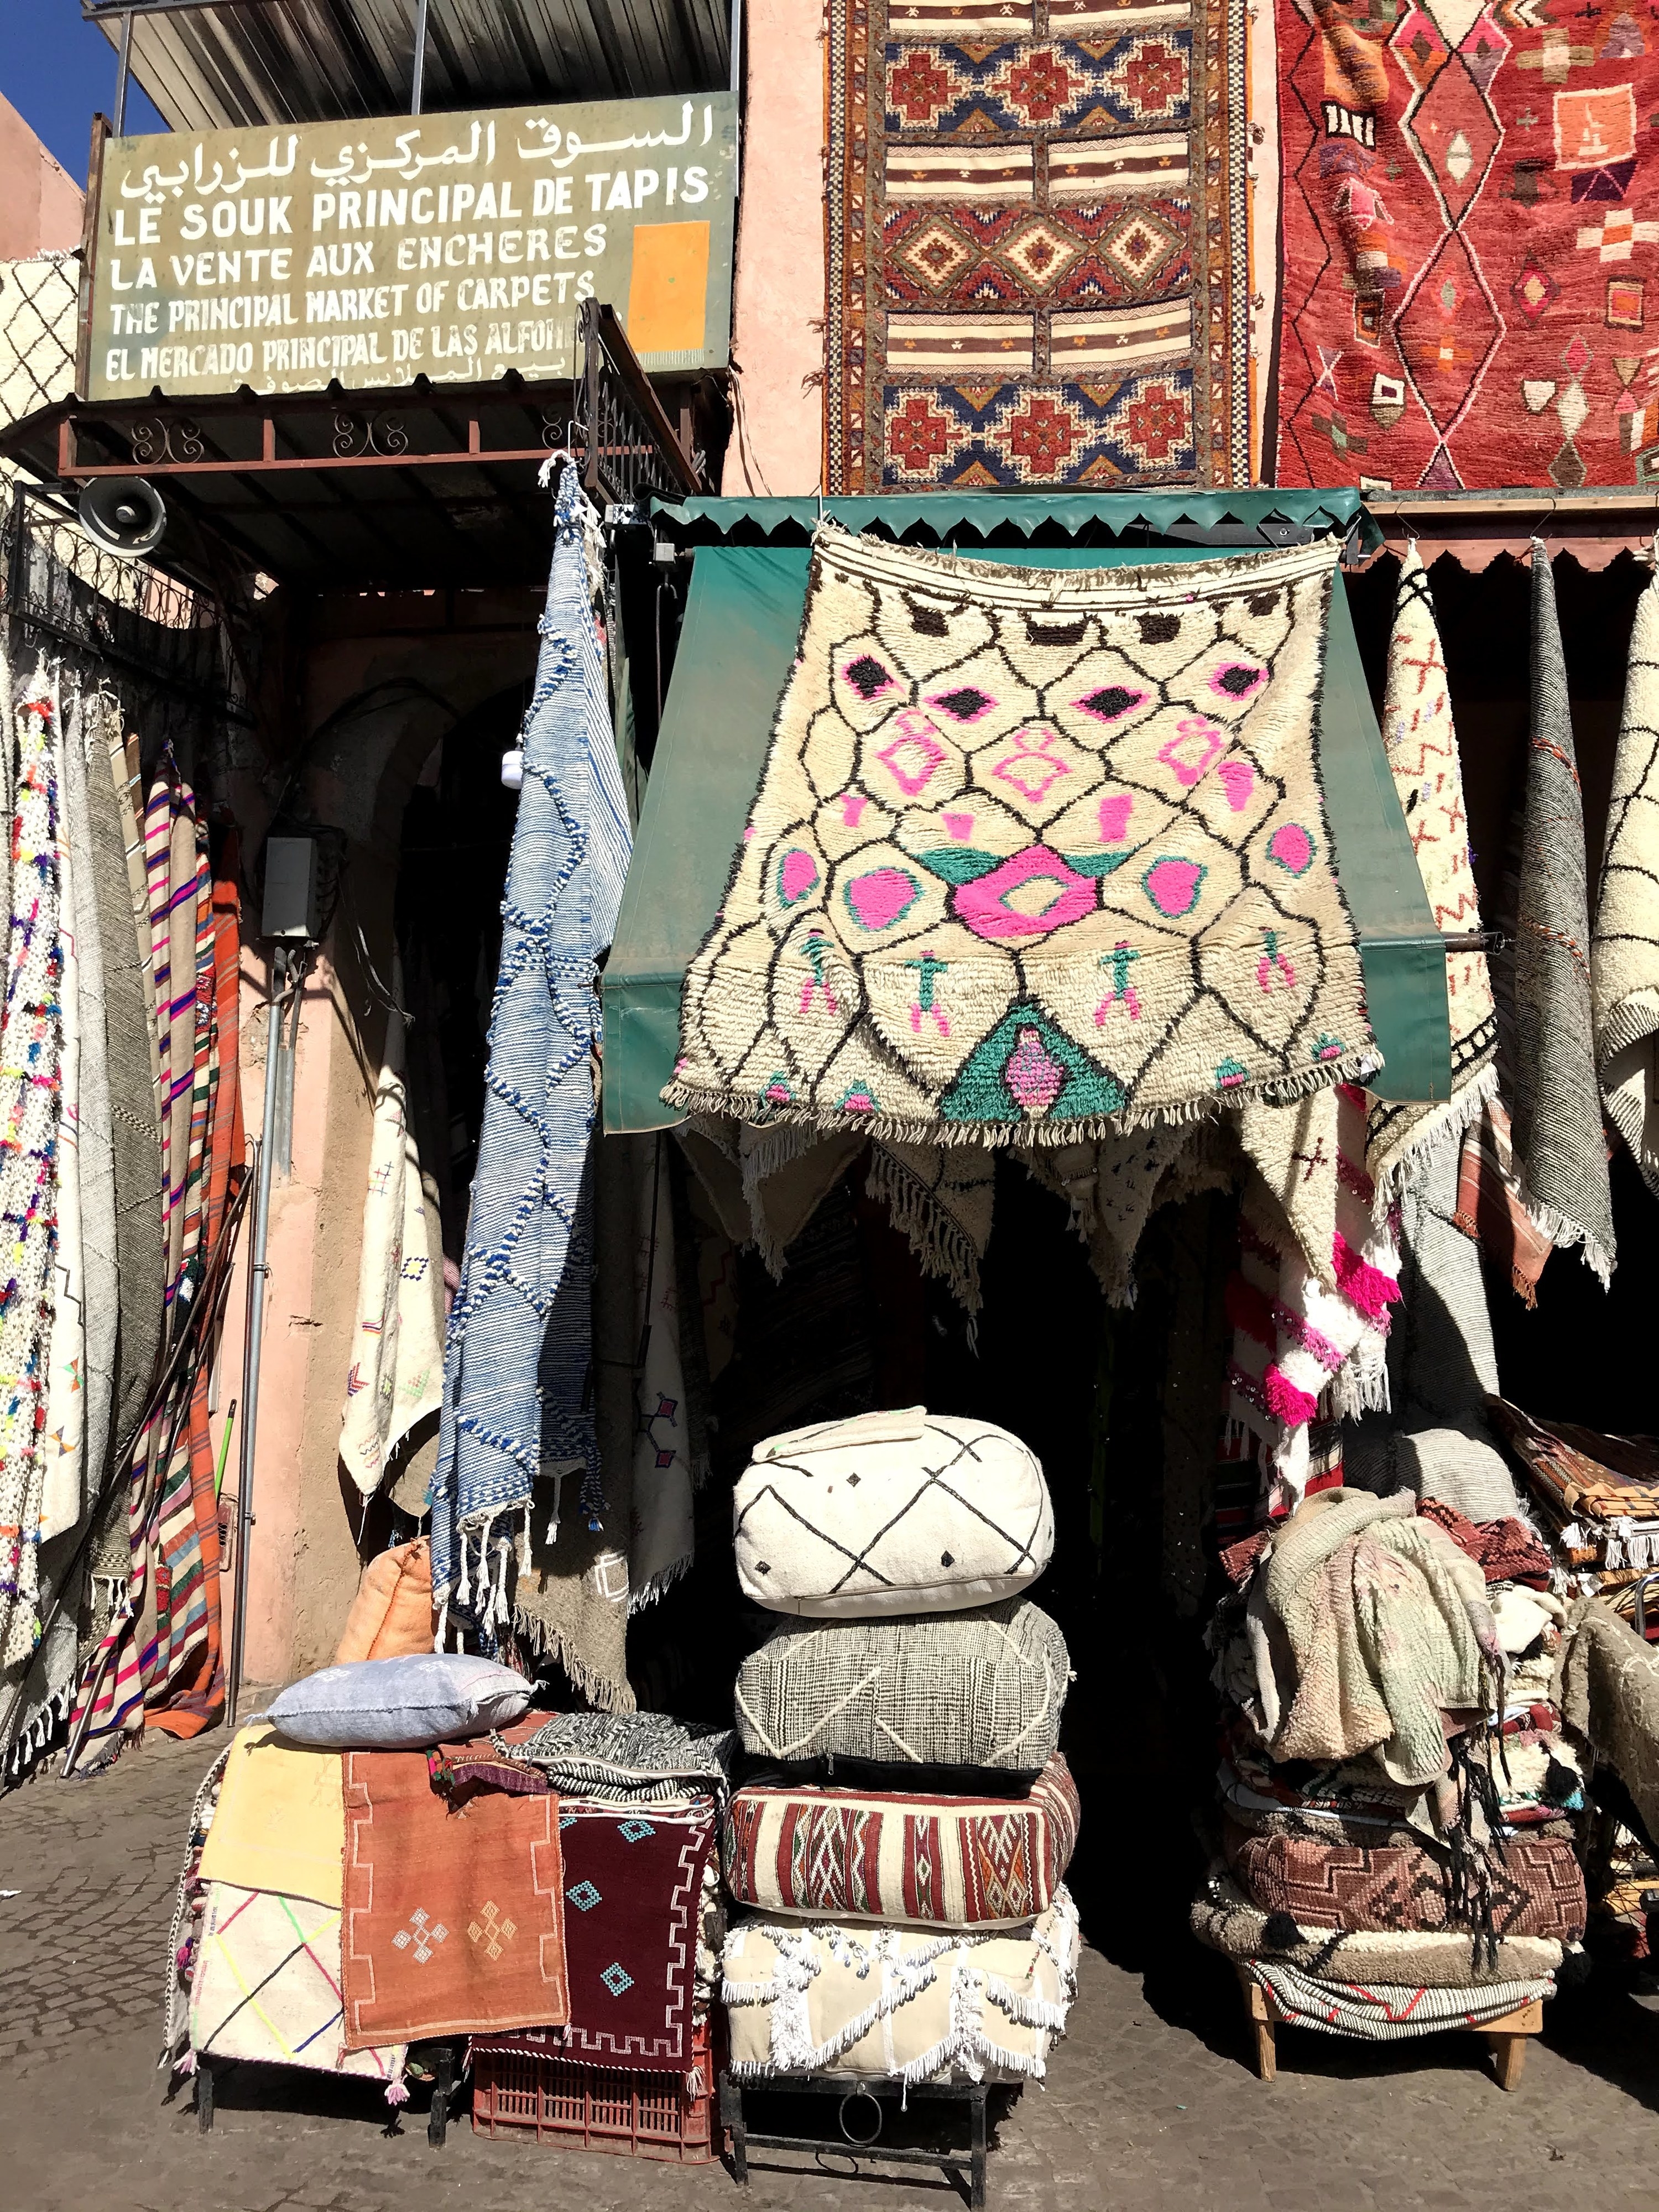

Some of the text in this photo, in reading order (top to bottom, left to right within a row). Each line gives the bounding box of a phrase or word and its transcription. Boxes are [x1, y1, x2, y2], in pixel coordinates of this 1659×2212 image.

[121, 101, 713, 204] السوق المركزي للزرابي
[114, 166, 709, 246] LE SOUK PRINCIPAL DE TAPIS
[111, 223, 607, 291] LA VENTE AUX ENCHERES
[111, 270, 594, 335] THE PRINCIPAL MARKET OF CARPETS
[106, 348, 136, 380] EL
[141, 342, 253, 379] MERCADO
[262, 332, 387, 372] PRINCIPAL
[392, 326, 425, 362] DE
[432, 324, 478, 358] LAS
